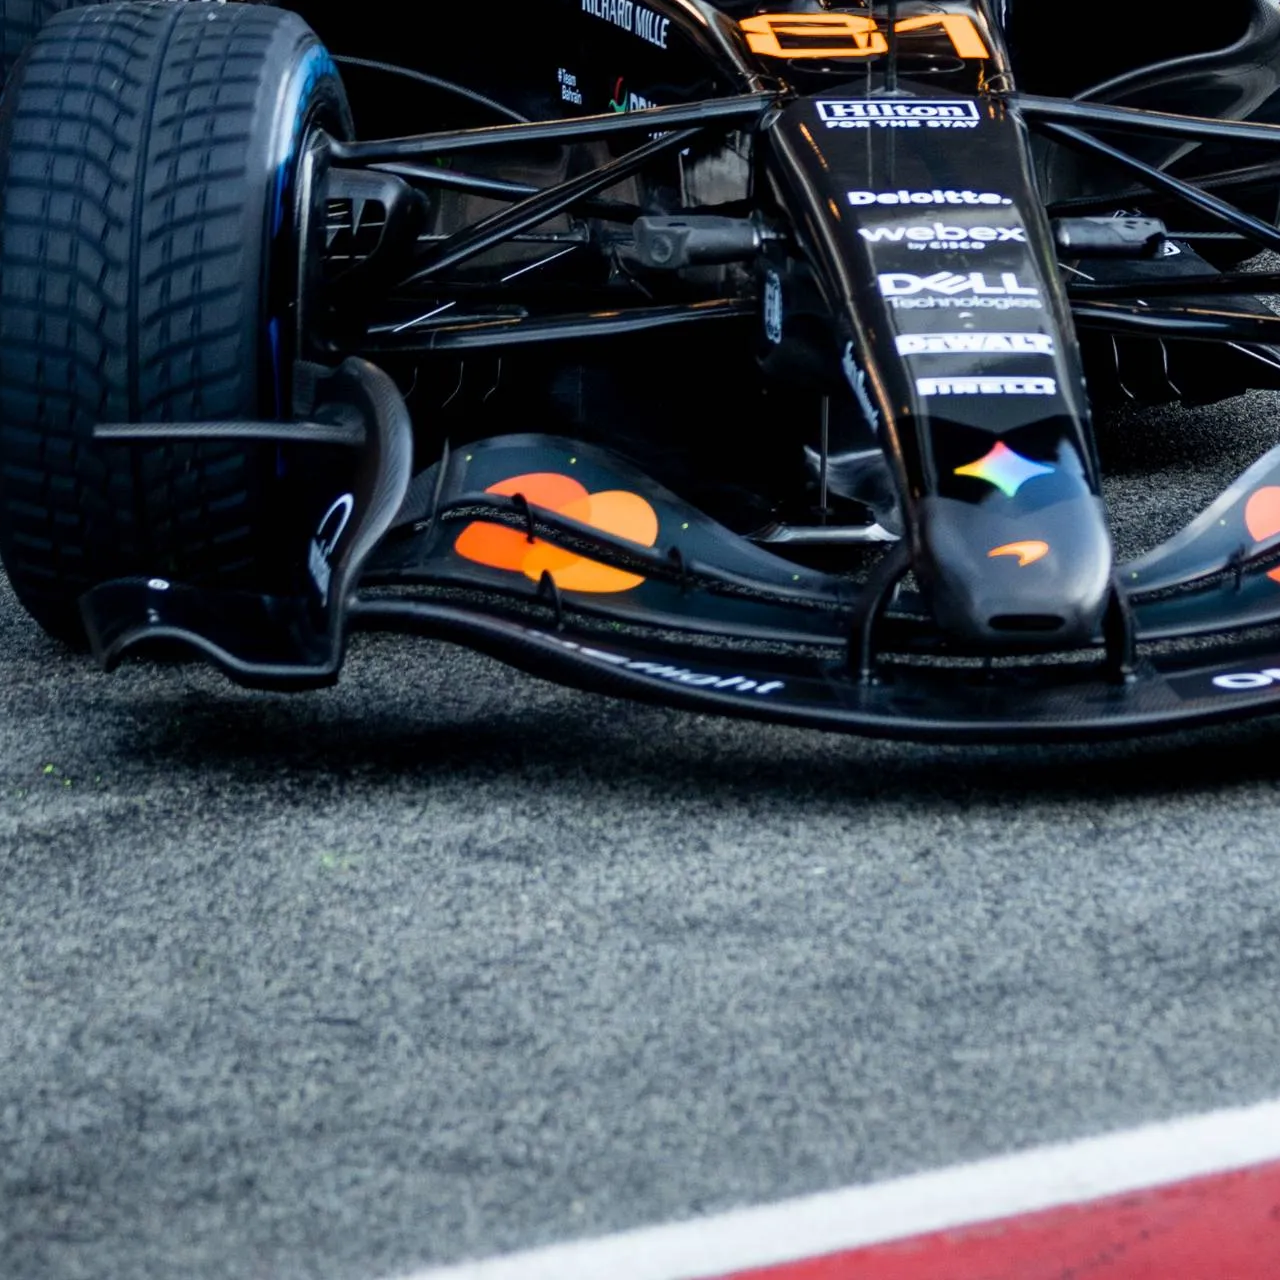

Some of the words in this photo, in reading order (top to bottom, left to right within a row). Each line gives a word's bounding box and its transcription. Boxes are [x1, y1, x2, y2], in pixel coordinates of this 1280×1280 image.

[635, 6, 670, 49] MILLE
[739, 13, 990, 58] 81
[829, 102, 966, 118] Hilton
[826, 120, 870, 129] FOR
[876, 120, 920, 128] THE
[927, 120, 979, 128] STAY
[858, 222, 1026, 242] webex
[908, 242, 926, 251] by
[877, 271, 1039, 296] DELL
[886, 296, 1043, 310] Technologies
